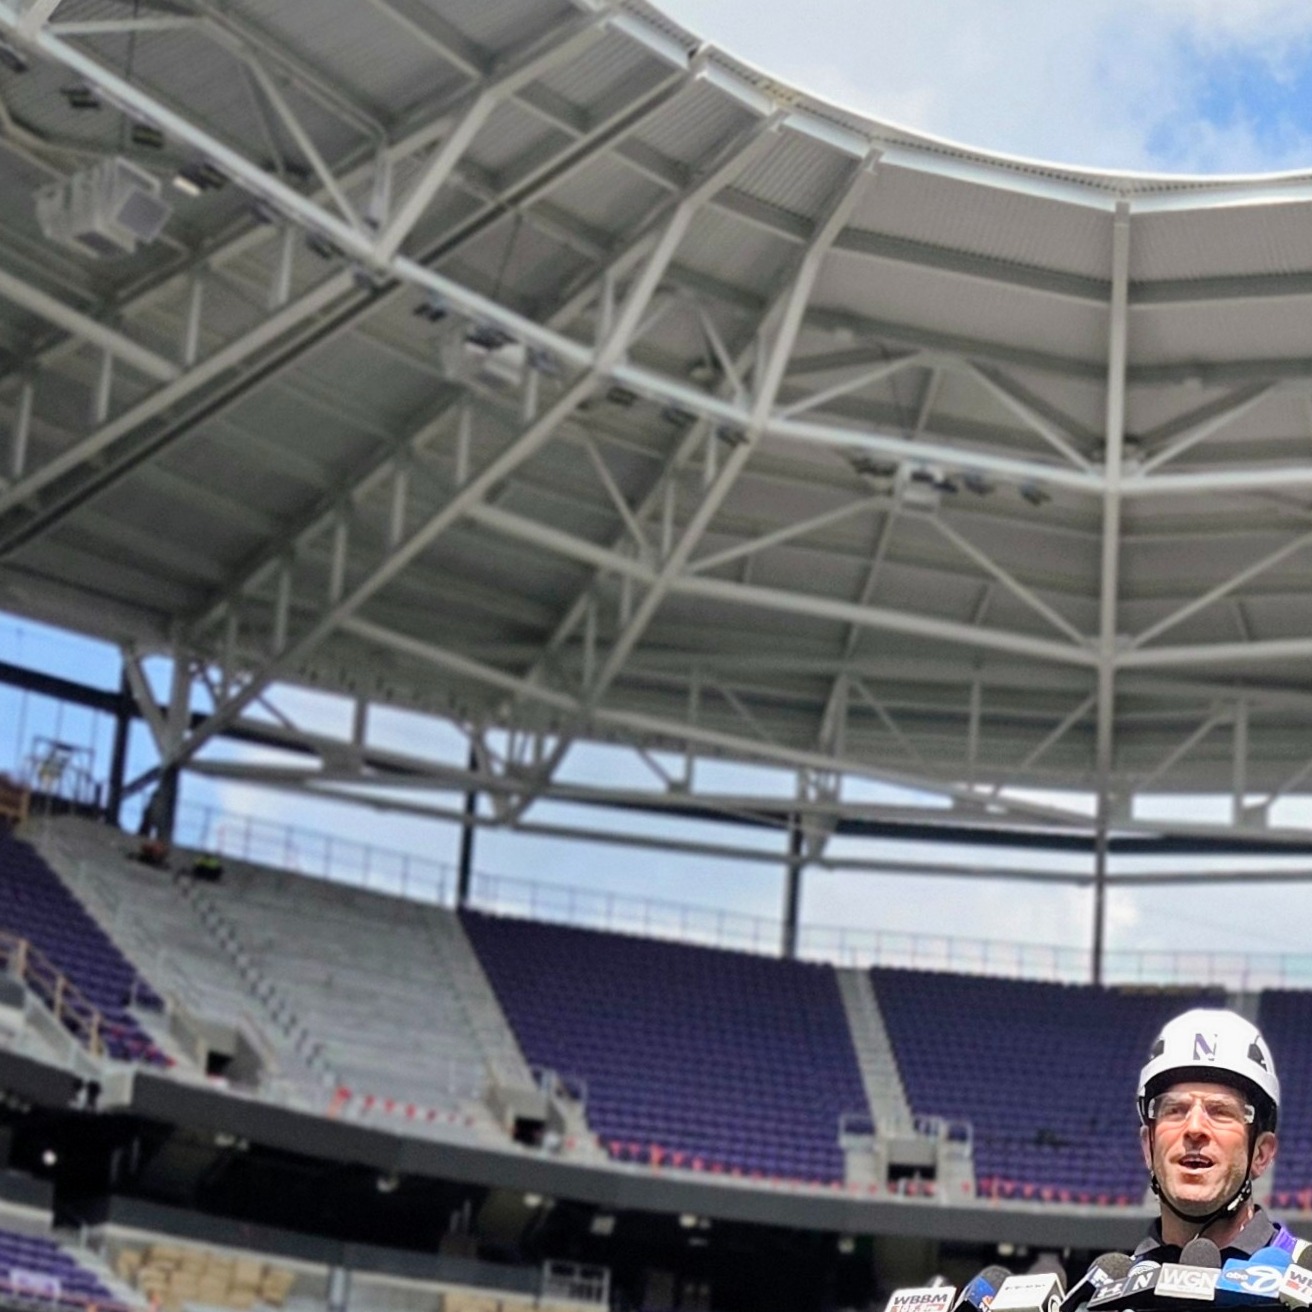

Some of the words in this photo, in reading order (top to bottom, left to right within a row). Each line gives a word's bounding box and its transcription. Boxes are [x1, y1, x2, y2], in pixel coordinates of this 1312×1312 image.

[1193, 1033, 1218, 1061] N
[1161, 1267, 1218, 1288] WGN
[1225, 1271, 1249, 1281] abc
[893, 1293, 948, 1305] WBBM
